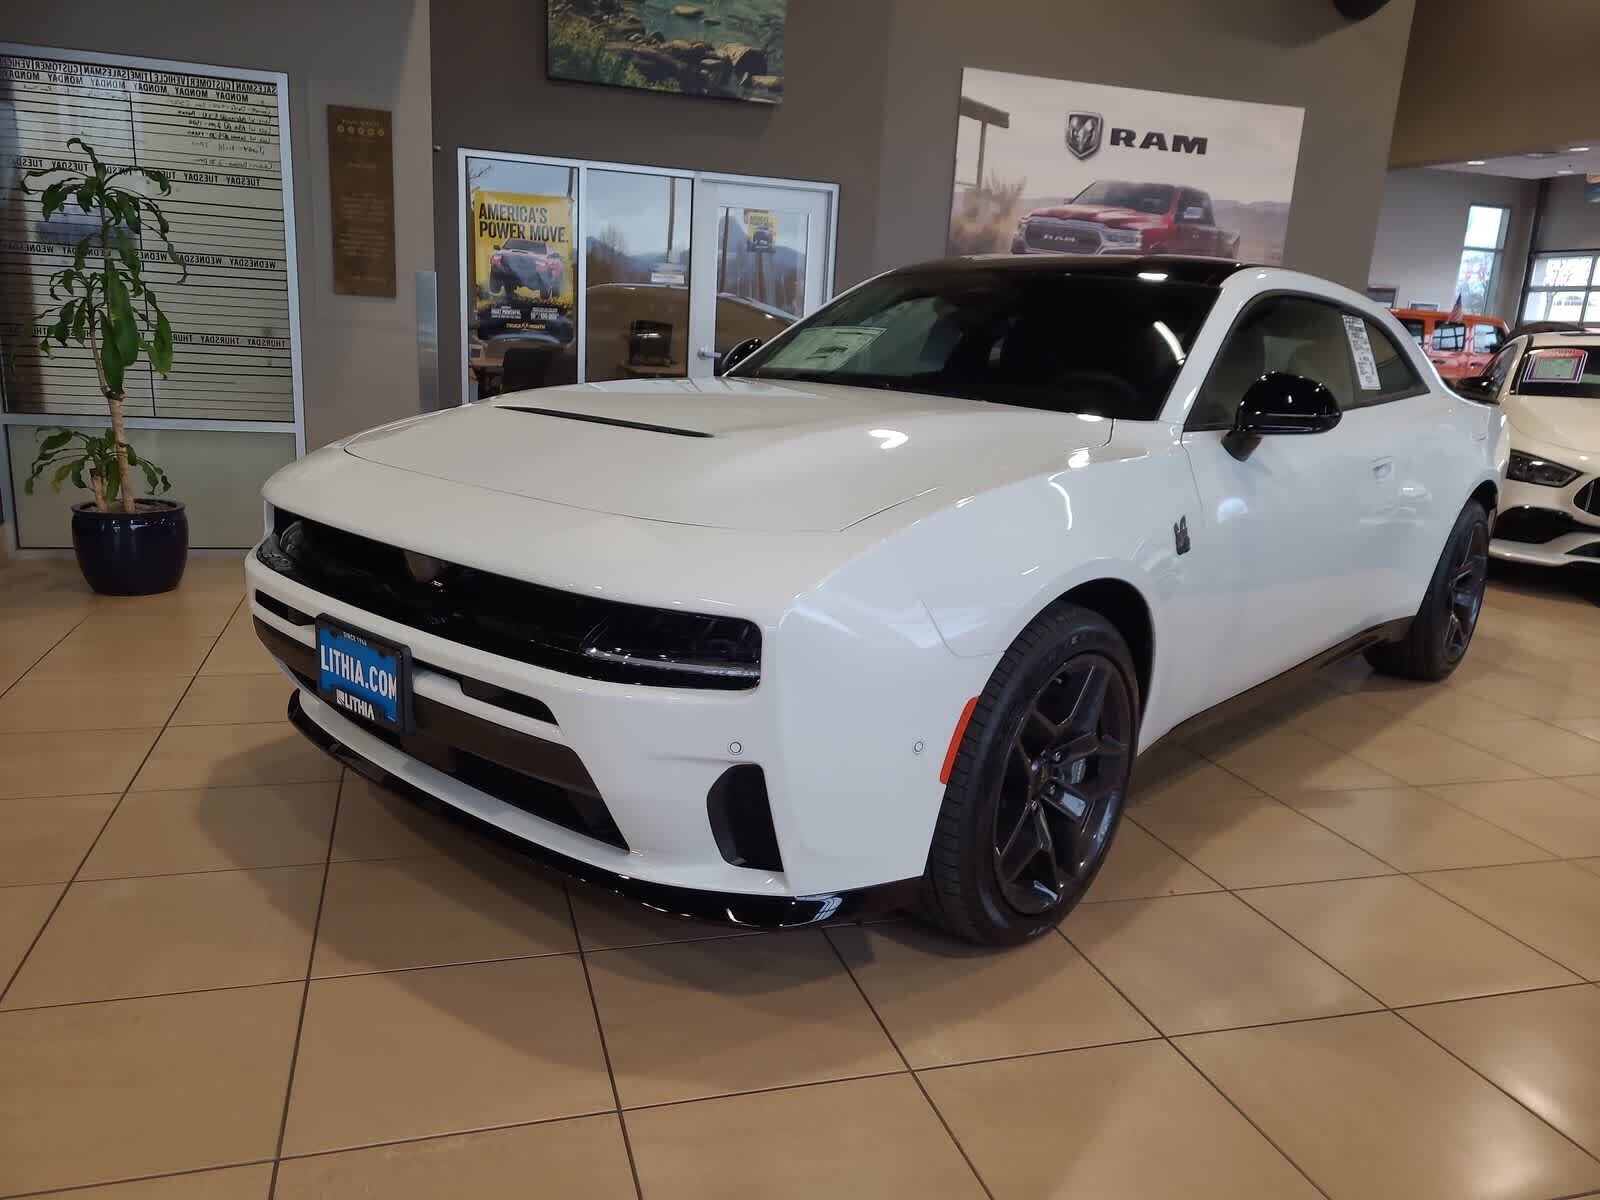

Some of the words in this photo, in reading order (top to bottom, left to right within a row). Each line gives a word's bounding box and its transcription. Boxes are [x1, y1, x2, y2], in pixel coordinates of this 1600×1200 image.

[1109, 127, 1208, 155] RAM
[479, 202, 547, 224] AMERICA'S
[480, 221, 525, 239] POWER
[530, 224, 569, 243] MOVE.
[320, 645, 397, 702] LITHIA.COM
[345, 692, 375, 720] LITHIA
